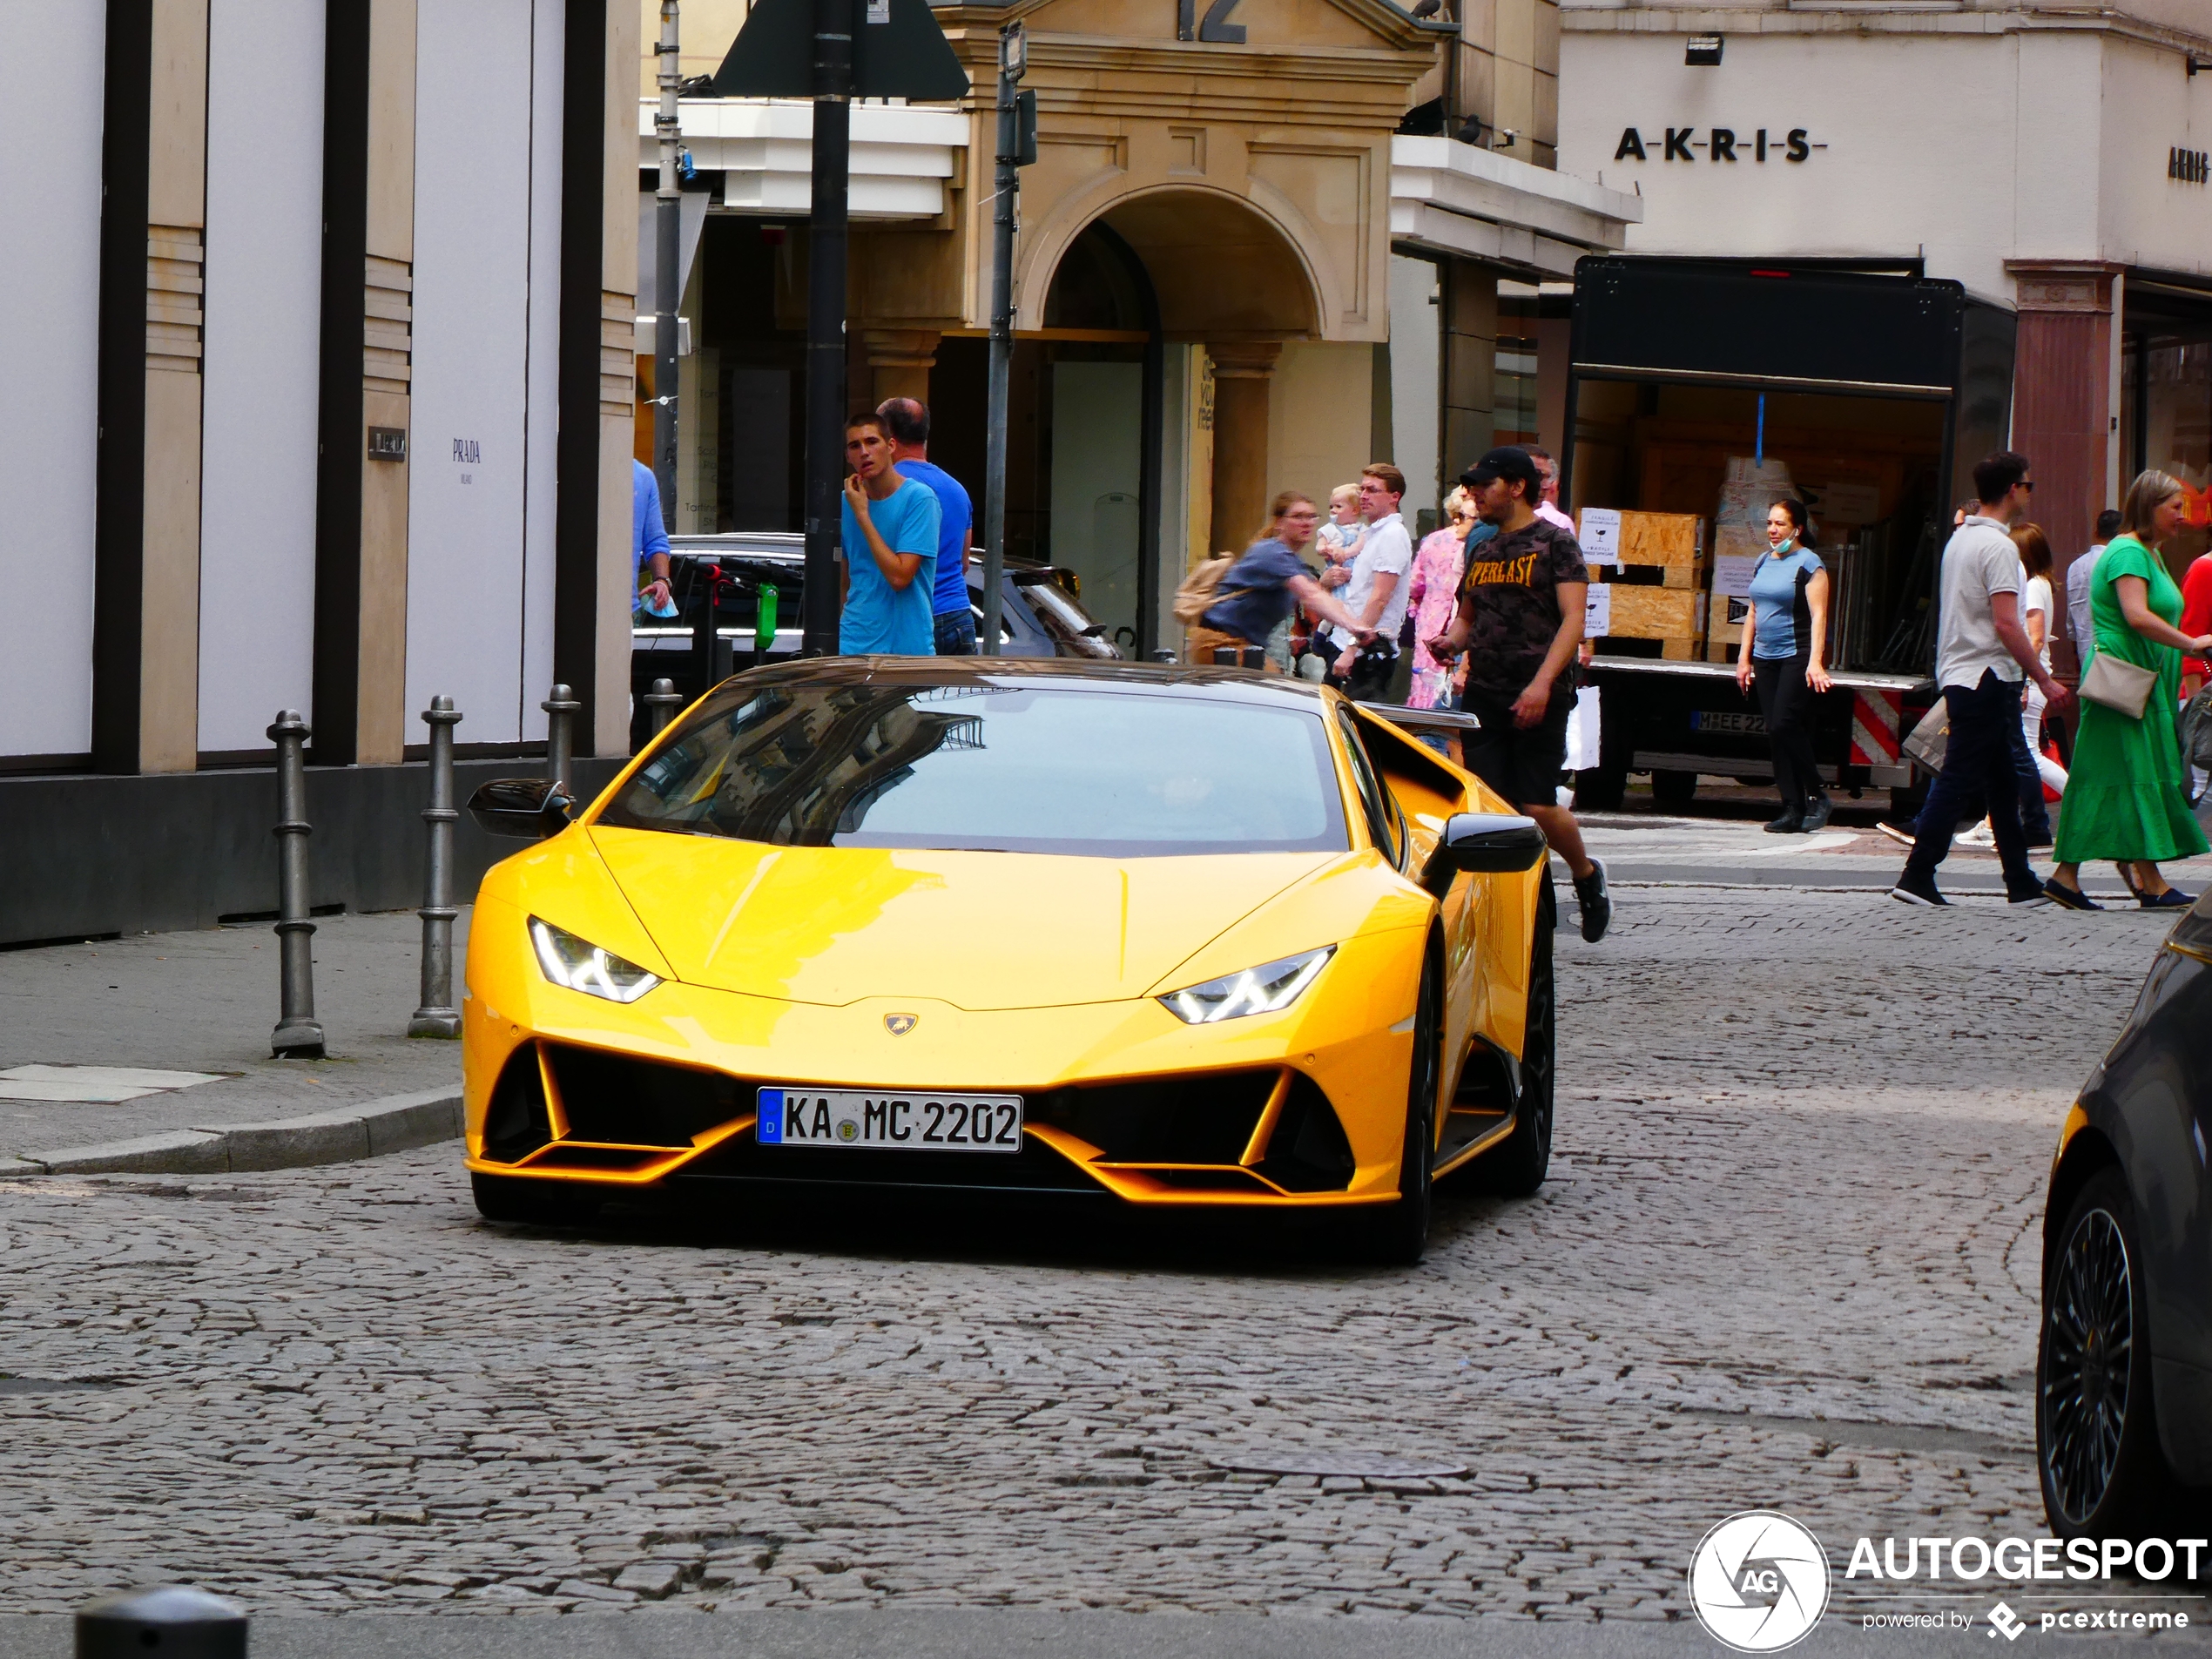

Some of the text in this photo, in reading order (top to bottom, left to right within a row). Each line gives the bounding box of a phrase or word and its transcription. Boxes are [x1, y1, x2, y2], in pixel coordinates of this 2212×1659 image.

[453, 437, 480, 463] PRADA
[1699, 714, 1710, 729] M
[1721, 715, 1742, 730] EE
[766, 1122, 775, 1133] D
[786, 1097, 1017, 1144] KA MC 2202
